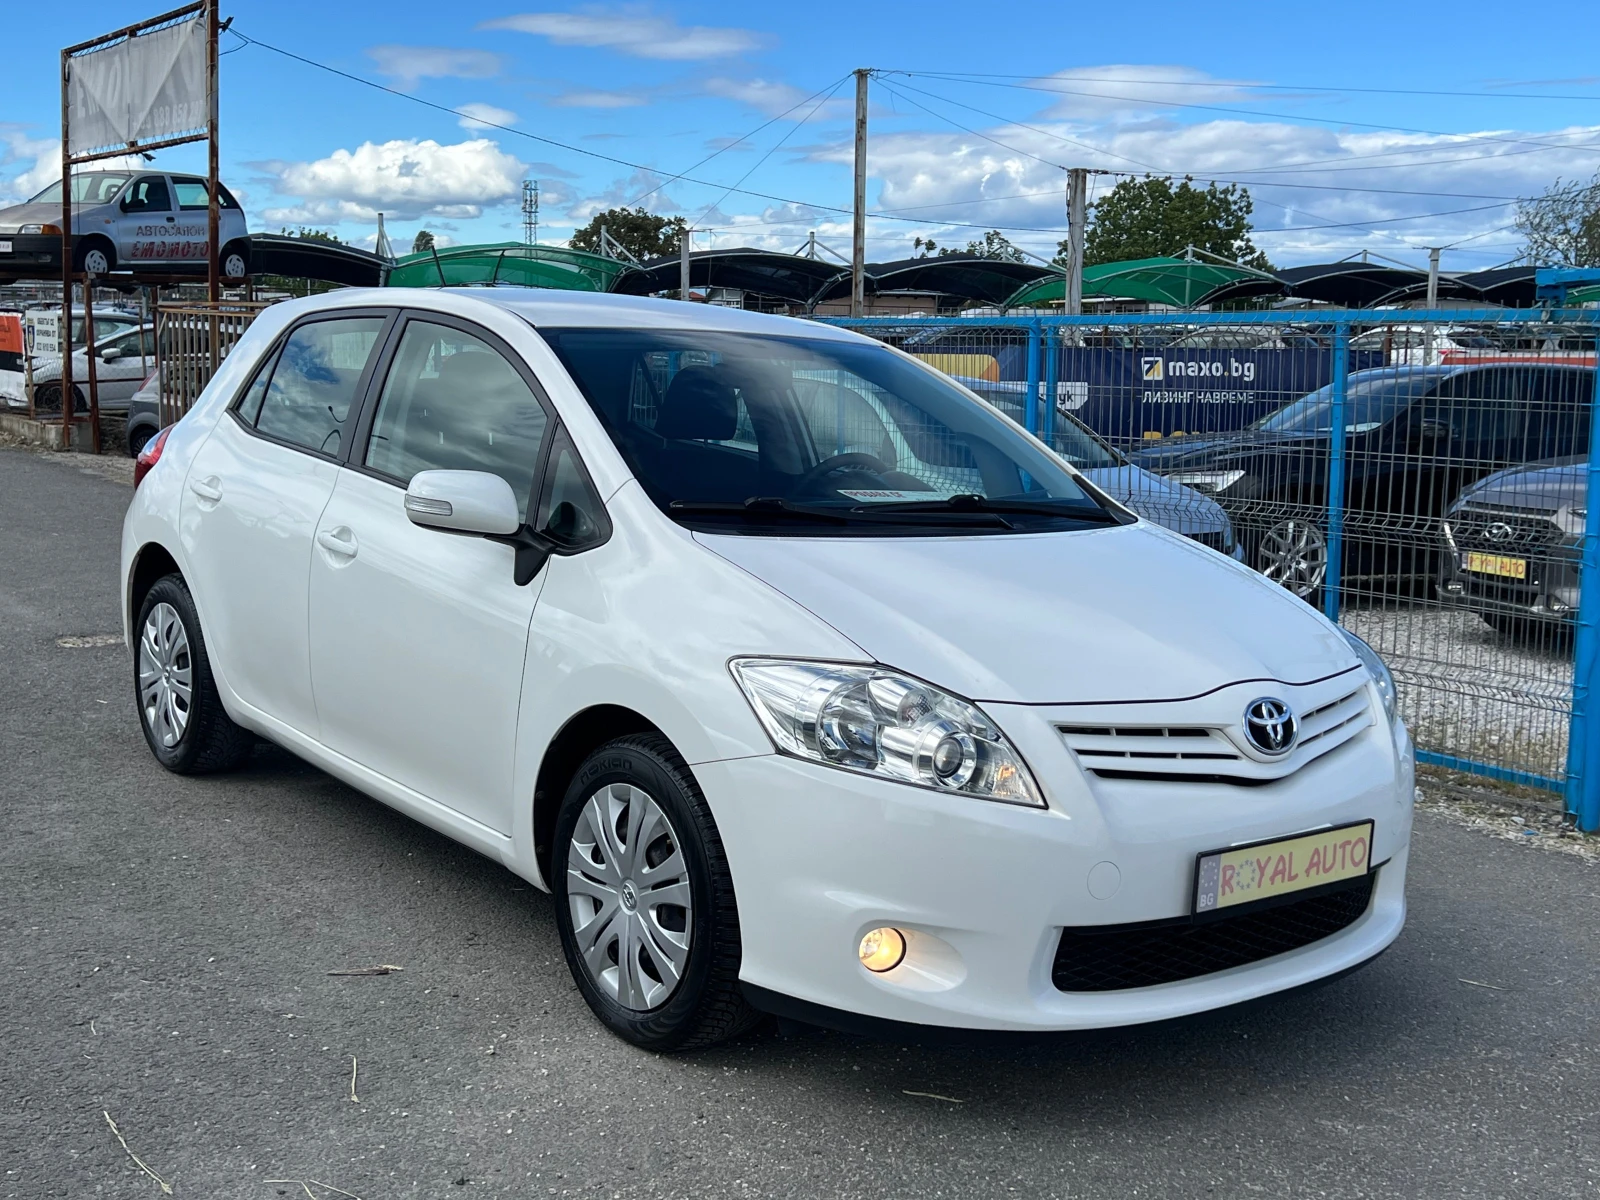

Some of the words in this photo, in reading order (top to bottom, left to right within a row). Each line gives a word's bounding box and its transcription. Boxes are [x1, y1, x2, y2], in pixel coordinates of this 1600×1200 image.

[1168, 358, 1255, 382] maxo.bg
[1142, 391, 1194, 404] ЛИЗИНГ
[1196, 392, 1254, 404] НАВРЕМЕ
[1304, 836, 1367, 878] AUTO
[1199, 892, 1214, 907] BG
